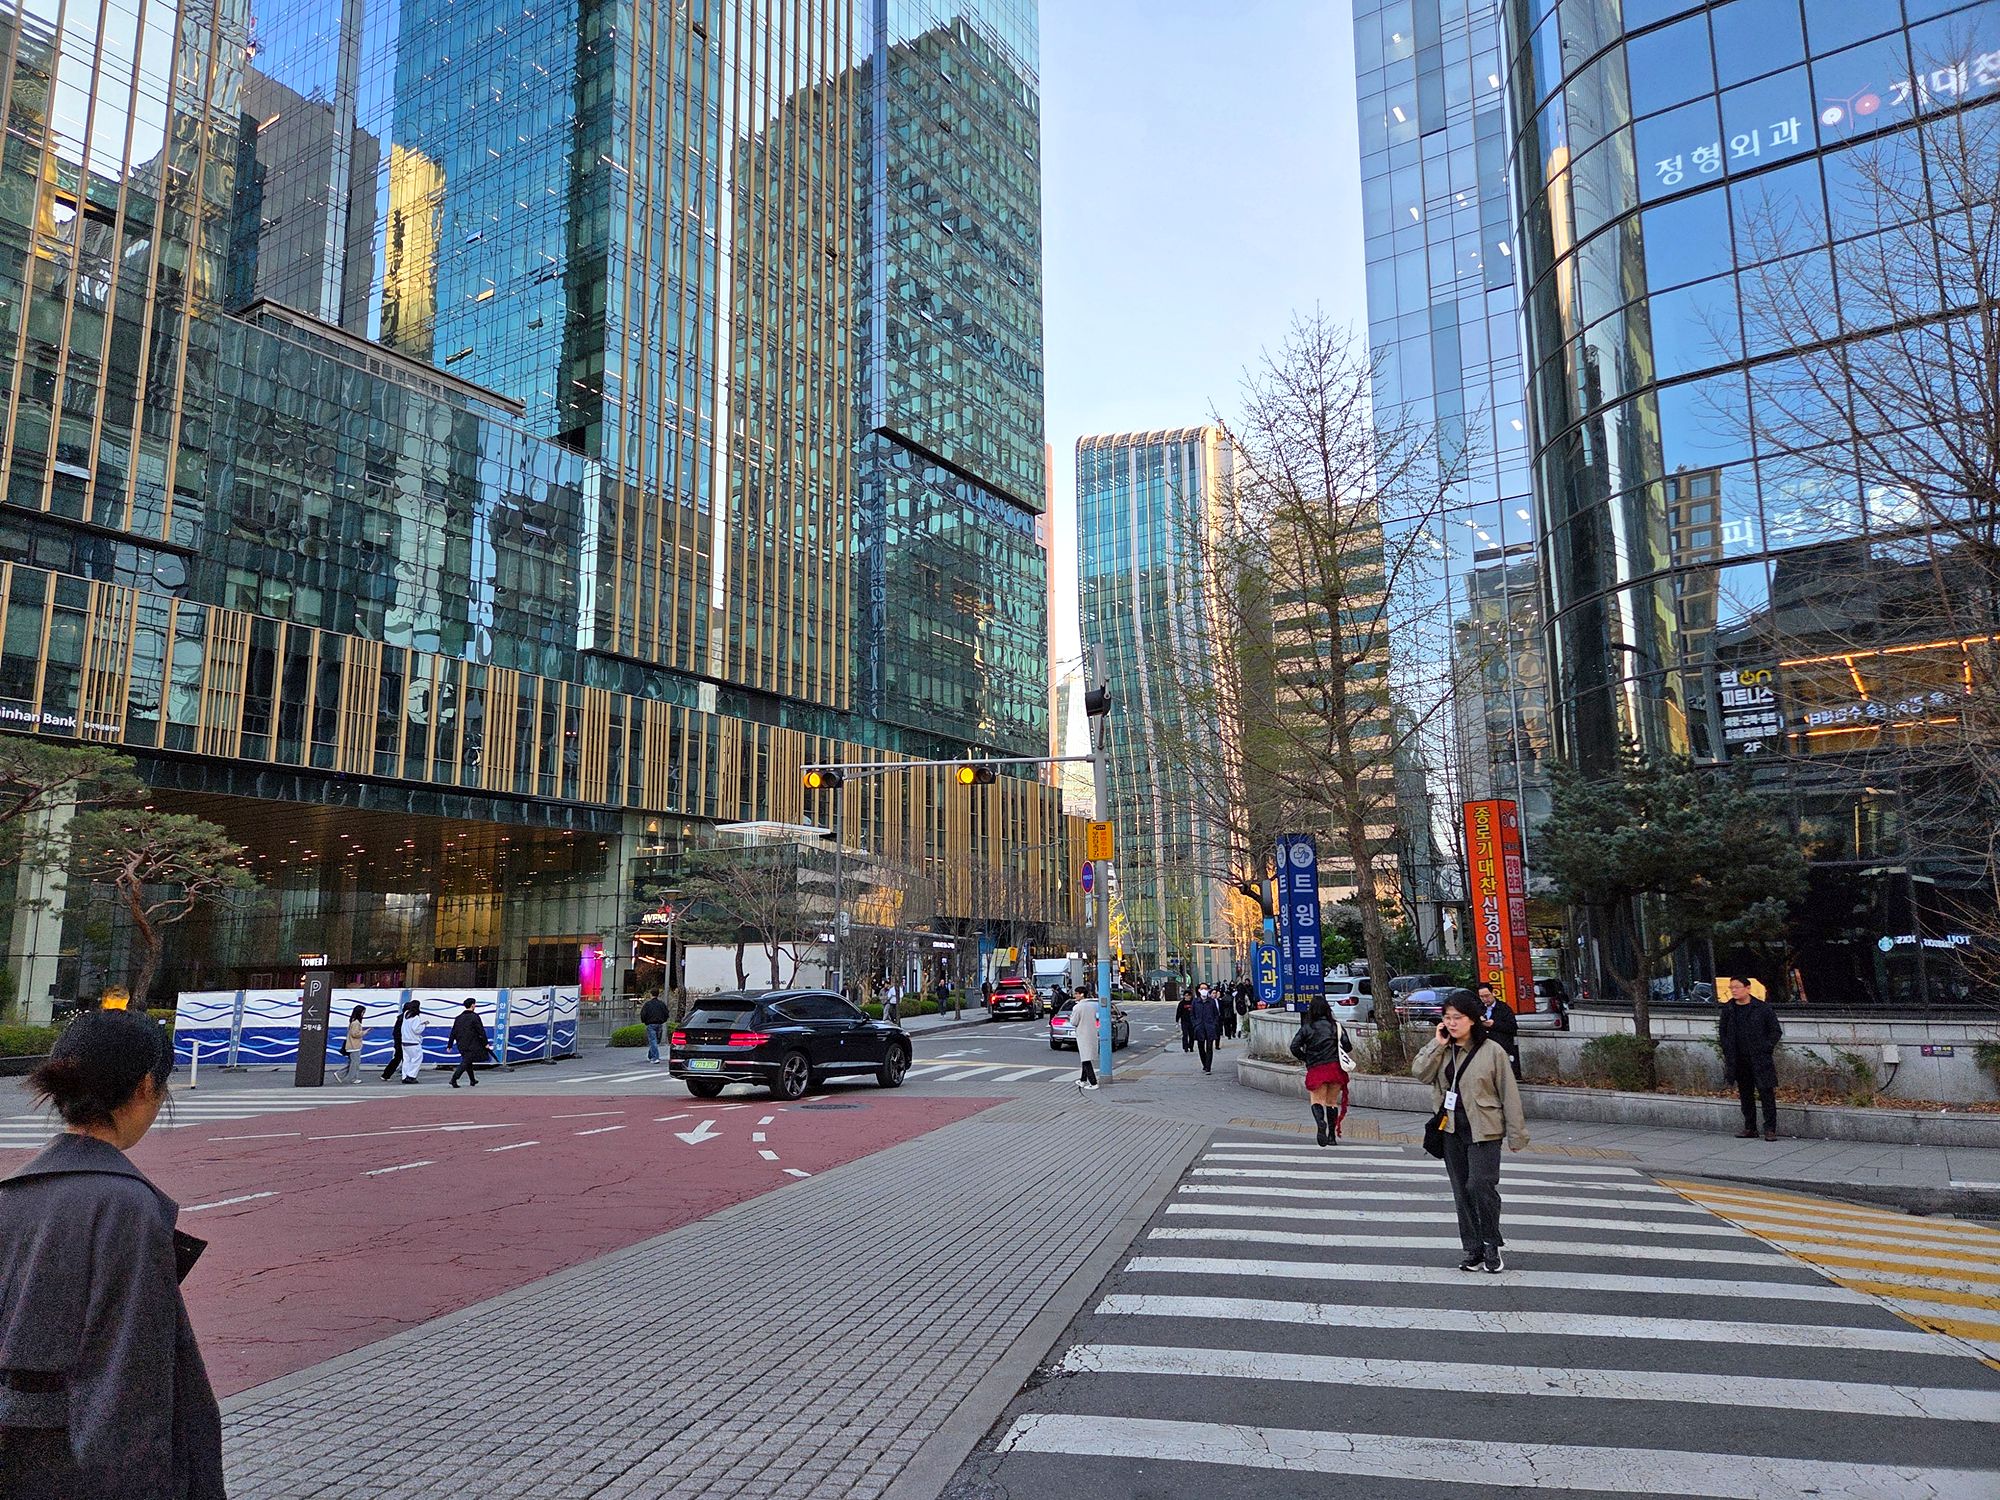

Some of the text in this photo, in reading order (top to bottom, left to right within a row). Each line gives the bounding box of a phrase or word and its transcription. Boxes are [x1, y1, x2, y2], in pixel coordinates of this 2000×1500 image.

[1654, 116, 1802, 186] 정형외과
[1721, 686, 1775, 707] 피트니스
[42, 712, 77, 728] Bank
[1743, 741, 1761, 753] 2F
[1294, 874, 1317, 958] 트윙클
[1260, 949, 1279, 988] 치과
[1298, 963, 1320, 976] 의원
[1264, 988, 1277, 999] 5F
